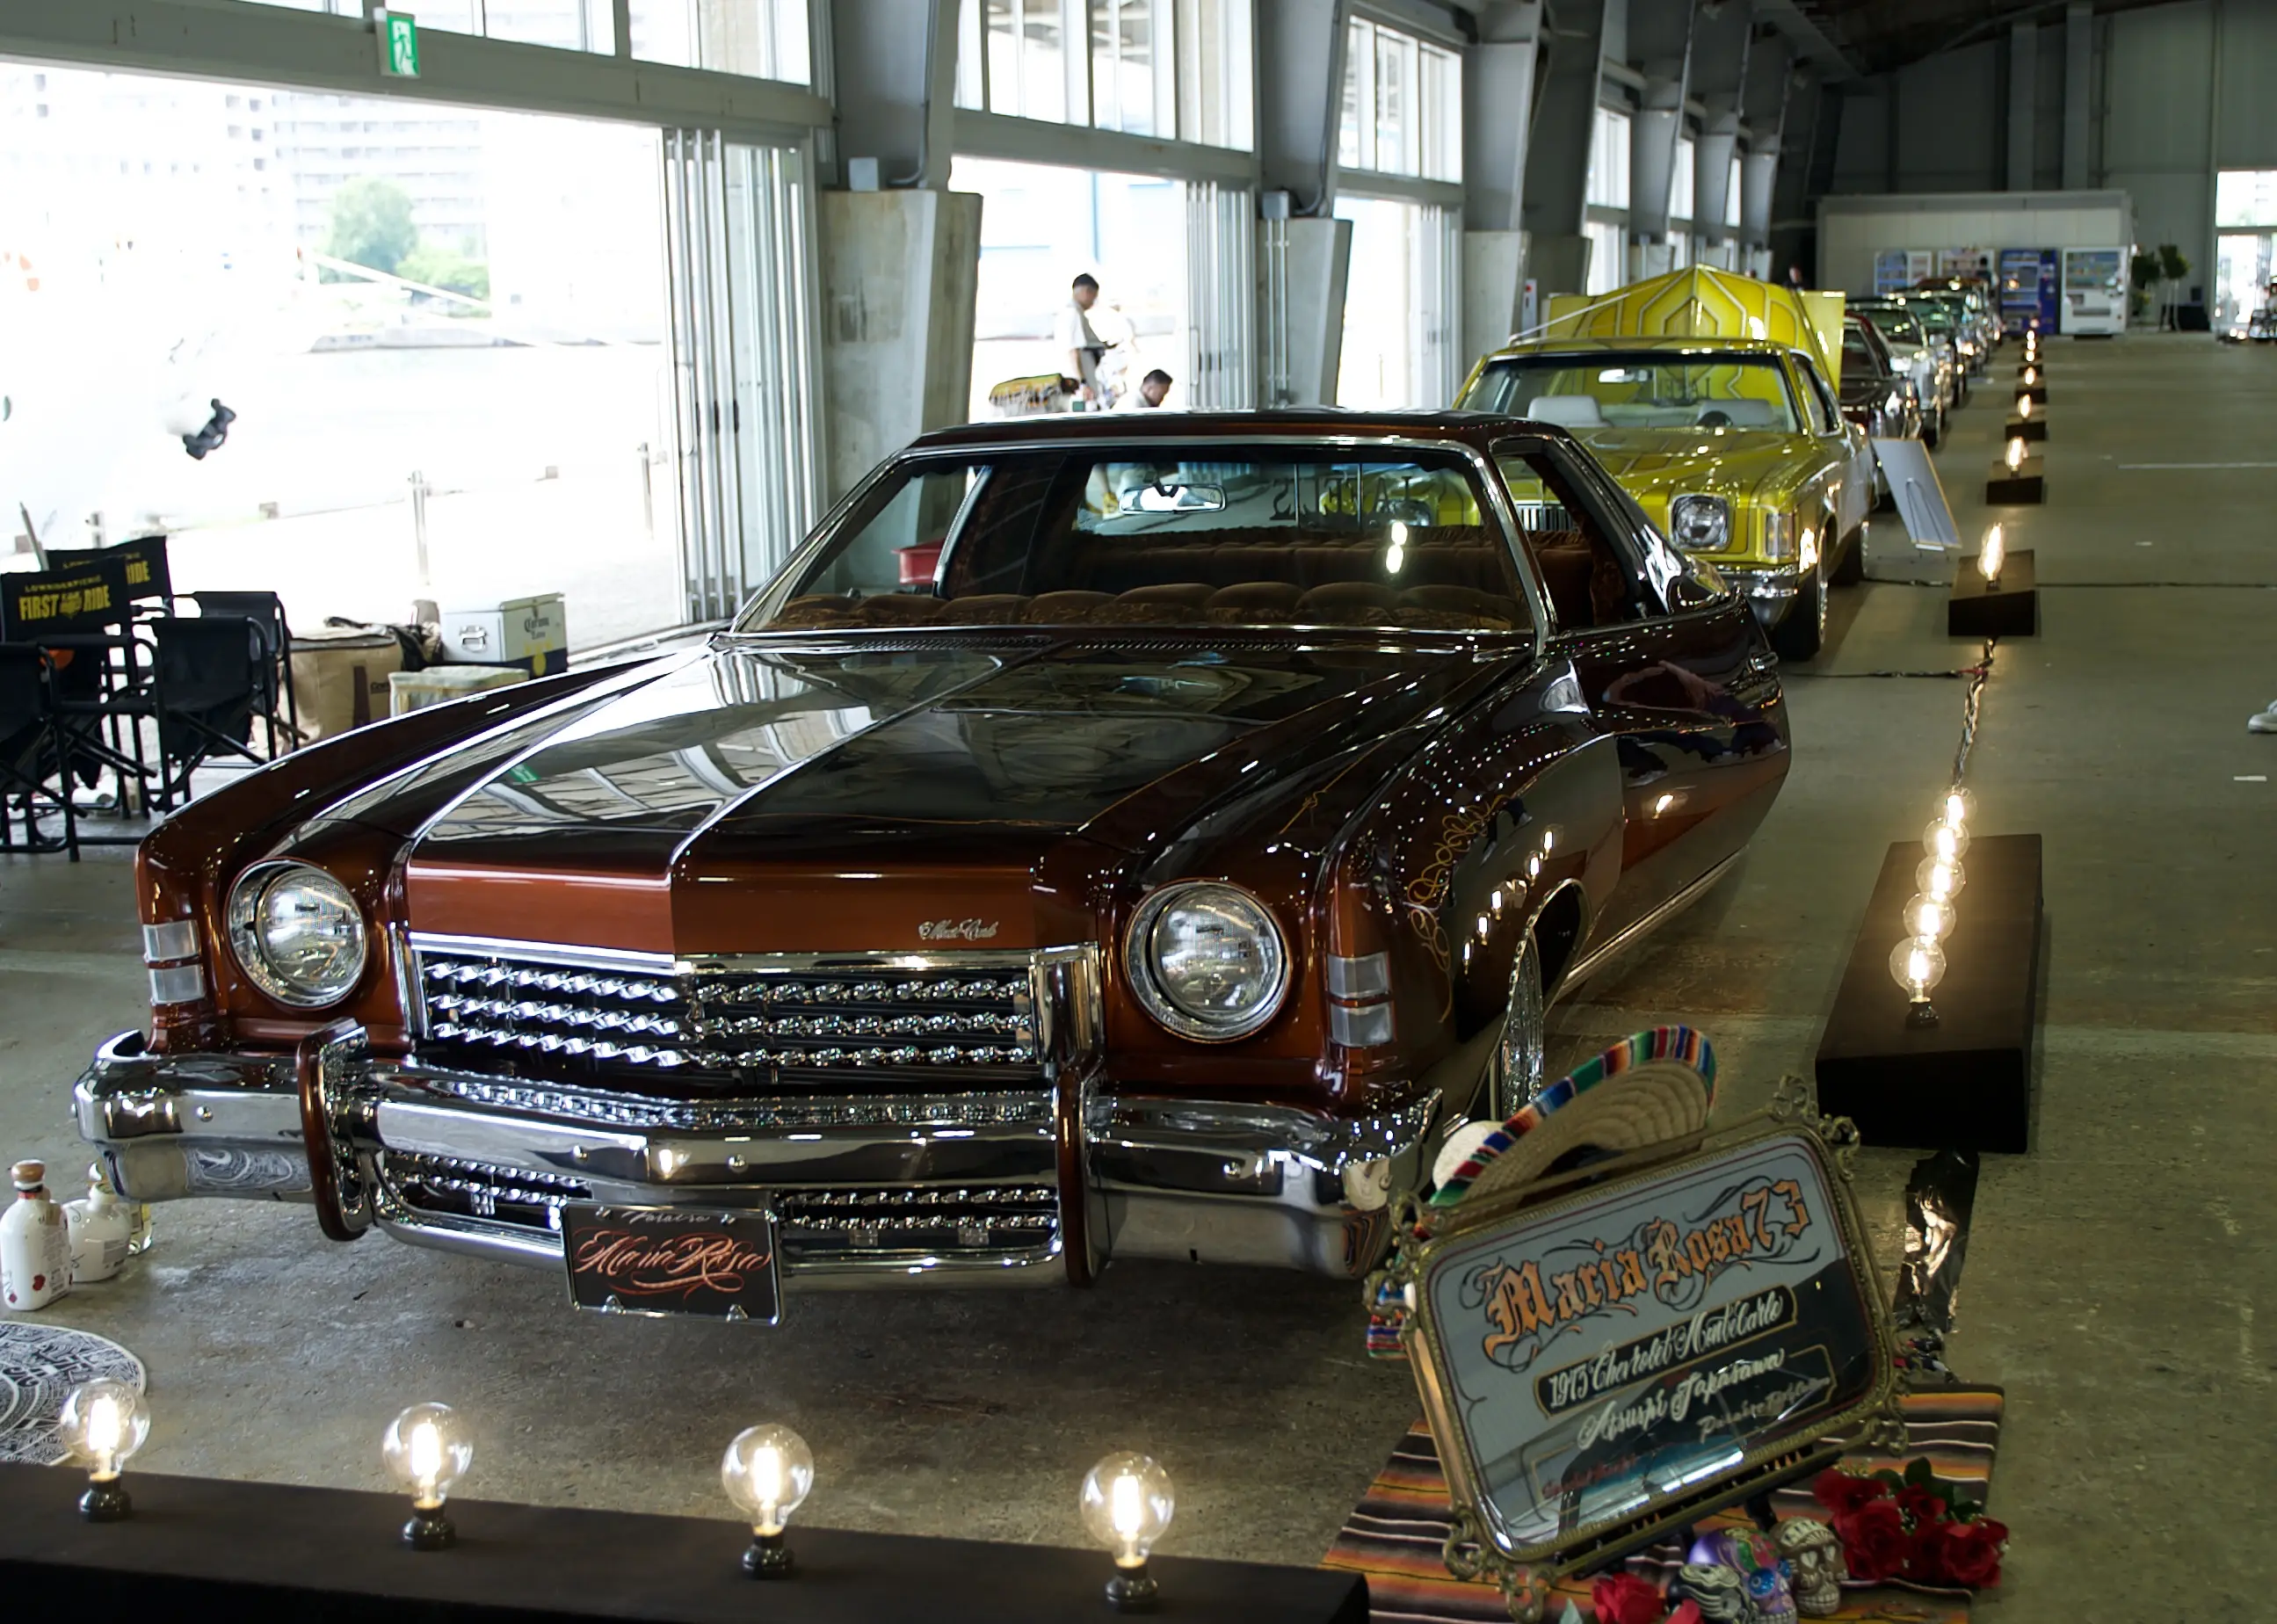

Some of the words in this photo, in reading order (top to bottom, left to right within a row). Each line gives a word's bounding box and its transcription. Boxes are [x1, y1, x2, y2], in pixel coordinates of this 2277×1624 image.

[18, 593, 61, 620] FIRST
[83, 584, 112, 613] RIDE
[1482, 1236, 1650, 1367] Maria
[1589, 1329, 1672, 1391] Chevrolet
